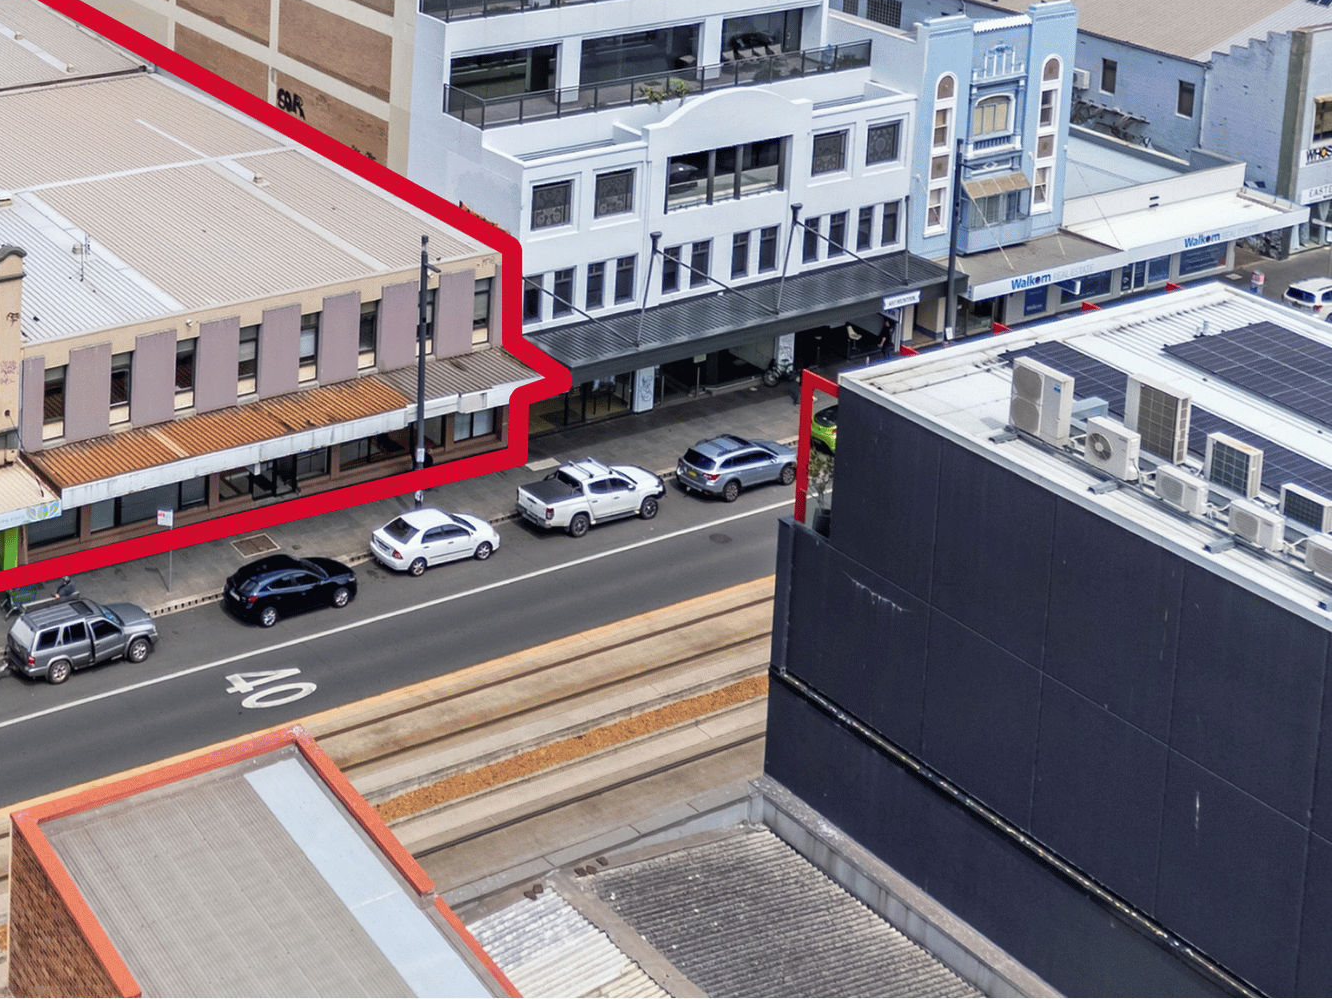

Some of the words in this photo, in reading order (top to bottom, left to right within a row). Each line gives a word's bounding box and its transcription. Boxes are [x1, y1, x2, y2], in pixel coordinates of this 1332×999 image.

[1184, 233, 1221, 248] Walkom
[1011, 273, 1051, 290] Walkom
[225, 668, 317, 708] 40
